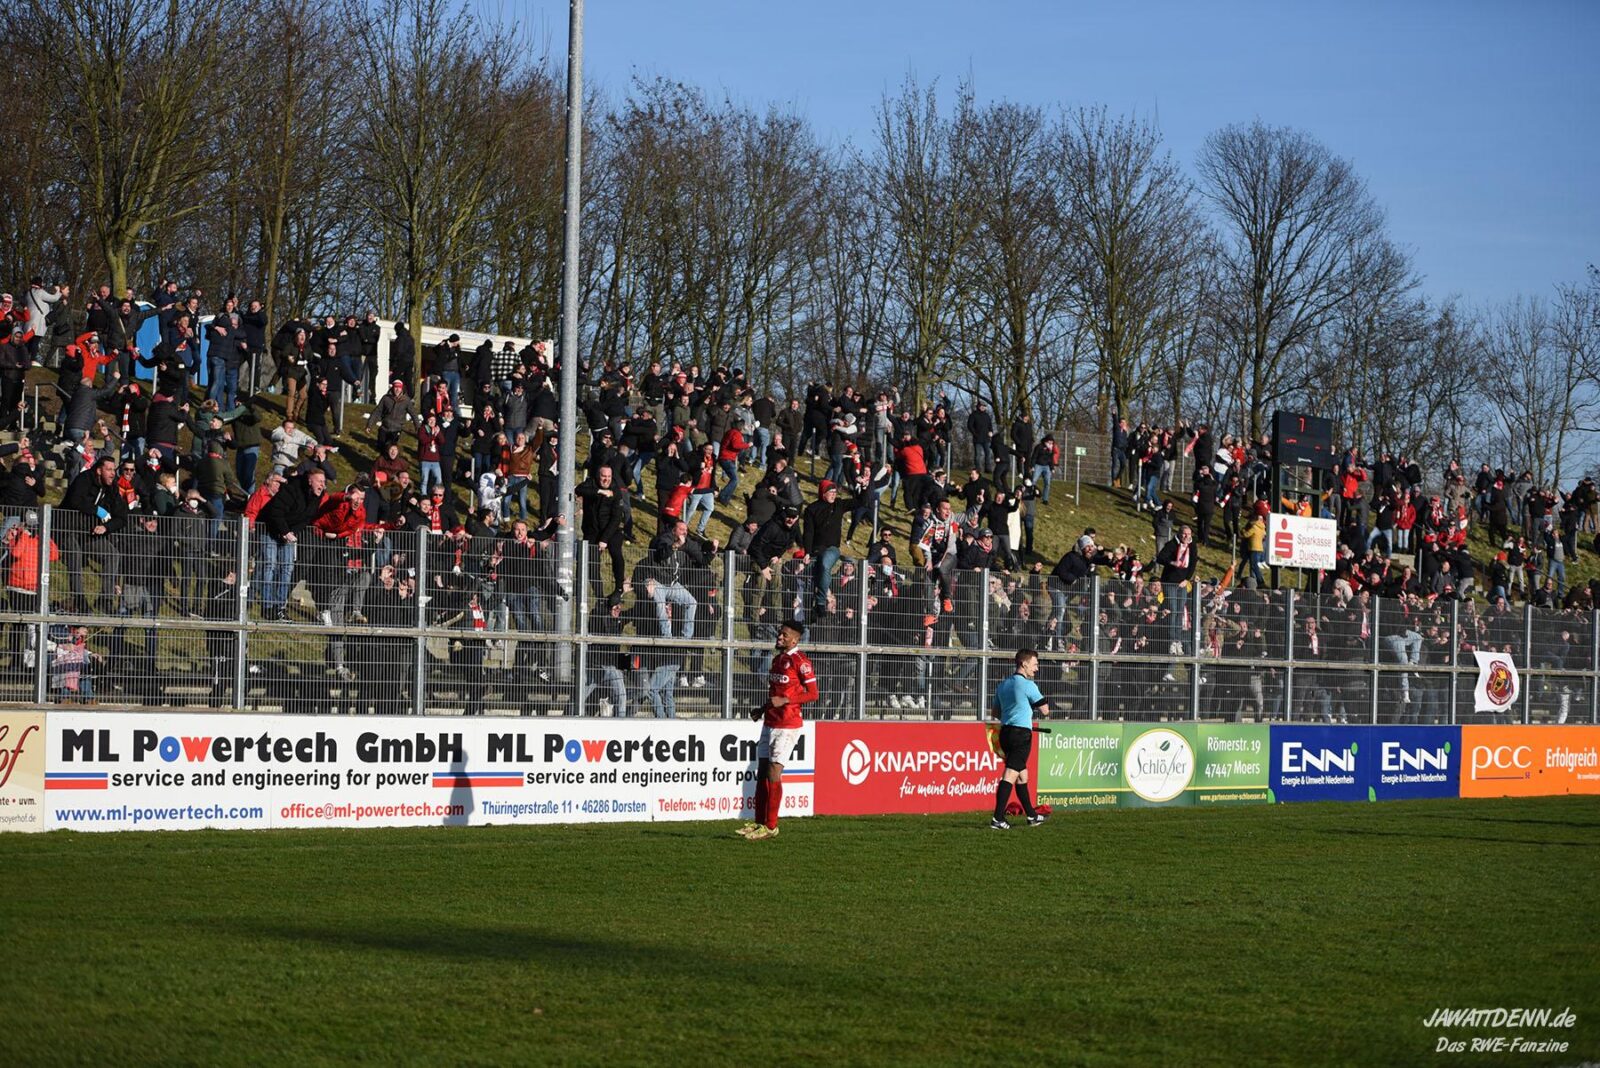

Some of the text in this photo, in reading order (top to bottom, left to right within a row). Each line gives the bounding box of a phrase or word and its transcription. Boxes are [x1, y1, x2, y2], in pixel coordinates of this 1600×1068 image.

[1296, 533, 1332, 548] Sparkasse
[62, 729, 463, 763] ML Powertech GmbH
[487, 733, 805, 763] ML Powertech GmH
[1039, 734, 1120, 750] Ihr Gartencenter
[1207, 737, 1261, 754] Römerstr. 19
[874, 751, 1004, 773] KNAPPSCHAF
[1050, 750, 1118, 779] in Moers
[1205, 760, 1260, 778] 47447 Moers
[1471, 745, 1532, 781] pcc
[1545, 746, 1598, 773] Erfolgreich
[112, 769, 430, 790] service and engineering for power
[526, 769, 585, 785] service
[590, 769, 618, 784] and
[622, 768, 708, 787] engineering
[712, 767, 732, 782] for
[1281, 776, 1300, 787] Energie
[1306, 775, 1324, 785] Umwelt
[1381, 774, 1398, 785] Energie
[900, 776, 1000, 799] für meine Gesundheit
[19, 798, 37, 806] uvm.
[482, 800, 647, 818] Thüringerstraße 11 46286 Dorsten
[658, 798, 697, 812] Telefon:
[699, 798, 716, 811] +49
[718, 798, 731, 813] (0)
[733, 797, 745, 810] 23
[785, 796, 796, 808] 83
[798, 796, 809, 808] 56
[1037, 795, 1117, 807] Erfahrung erkennt Qualität
[55, 804, 264, 824] www.ml-powertech.com
[280, 802, 465, 821] office@ml-powertech.com
